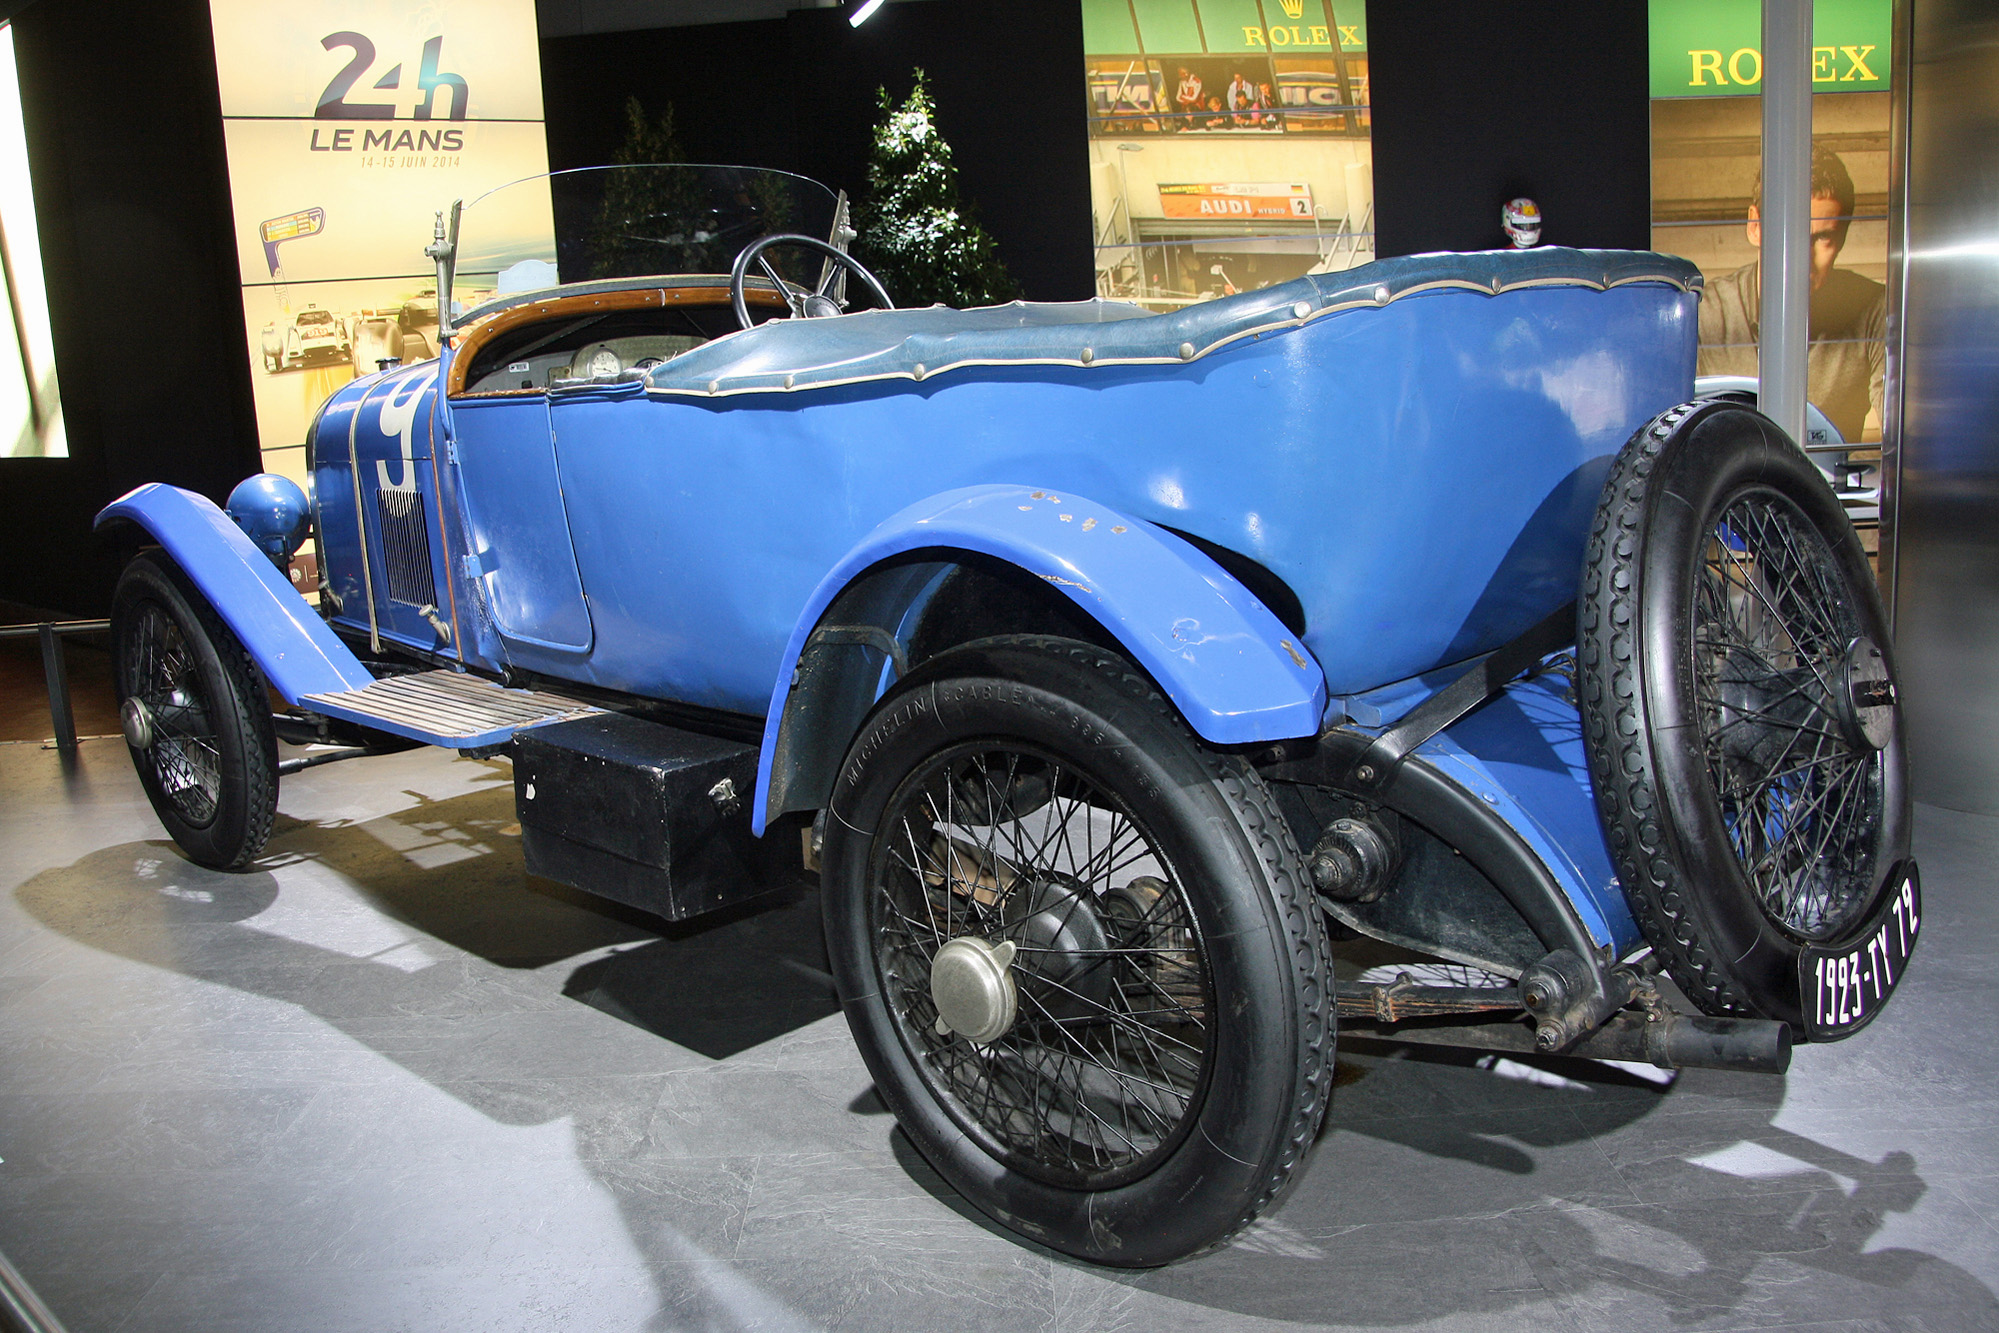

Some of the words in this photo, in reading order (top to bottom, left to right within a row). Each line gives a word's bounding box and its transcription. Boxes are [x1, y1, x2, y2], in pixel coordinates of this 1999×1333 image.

[1241, 25, 1363, 46] ROLEX
[314, 31, 469, 121] 24h
[1687, 45, 1880, 86] ROEX
[310, 128, 355, 152] LE
[362, 128, 464, 152] MANS
[361, 155, 395, 169] 14-15
[400, 155, 428, 168] JUIN
[432, 155, 461, 168] 2014
[1200, 199, 1252, 214] AUDI
[1296, 199, 1307, 214] 2
[375, 363, 441, 518] 9
[846, 696, 927, 787] MICHELIN
[1892, 877, 1920, 959] 72
